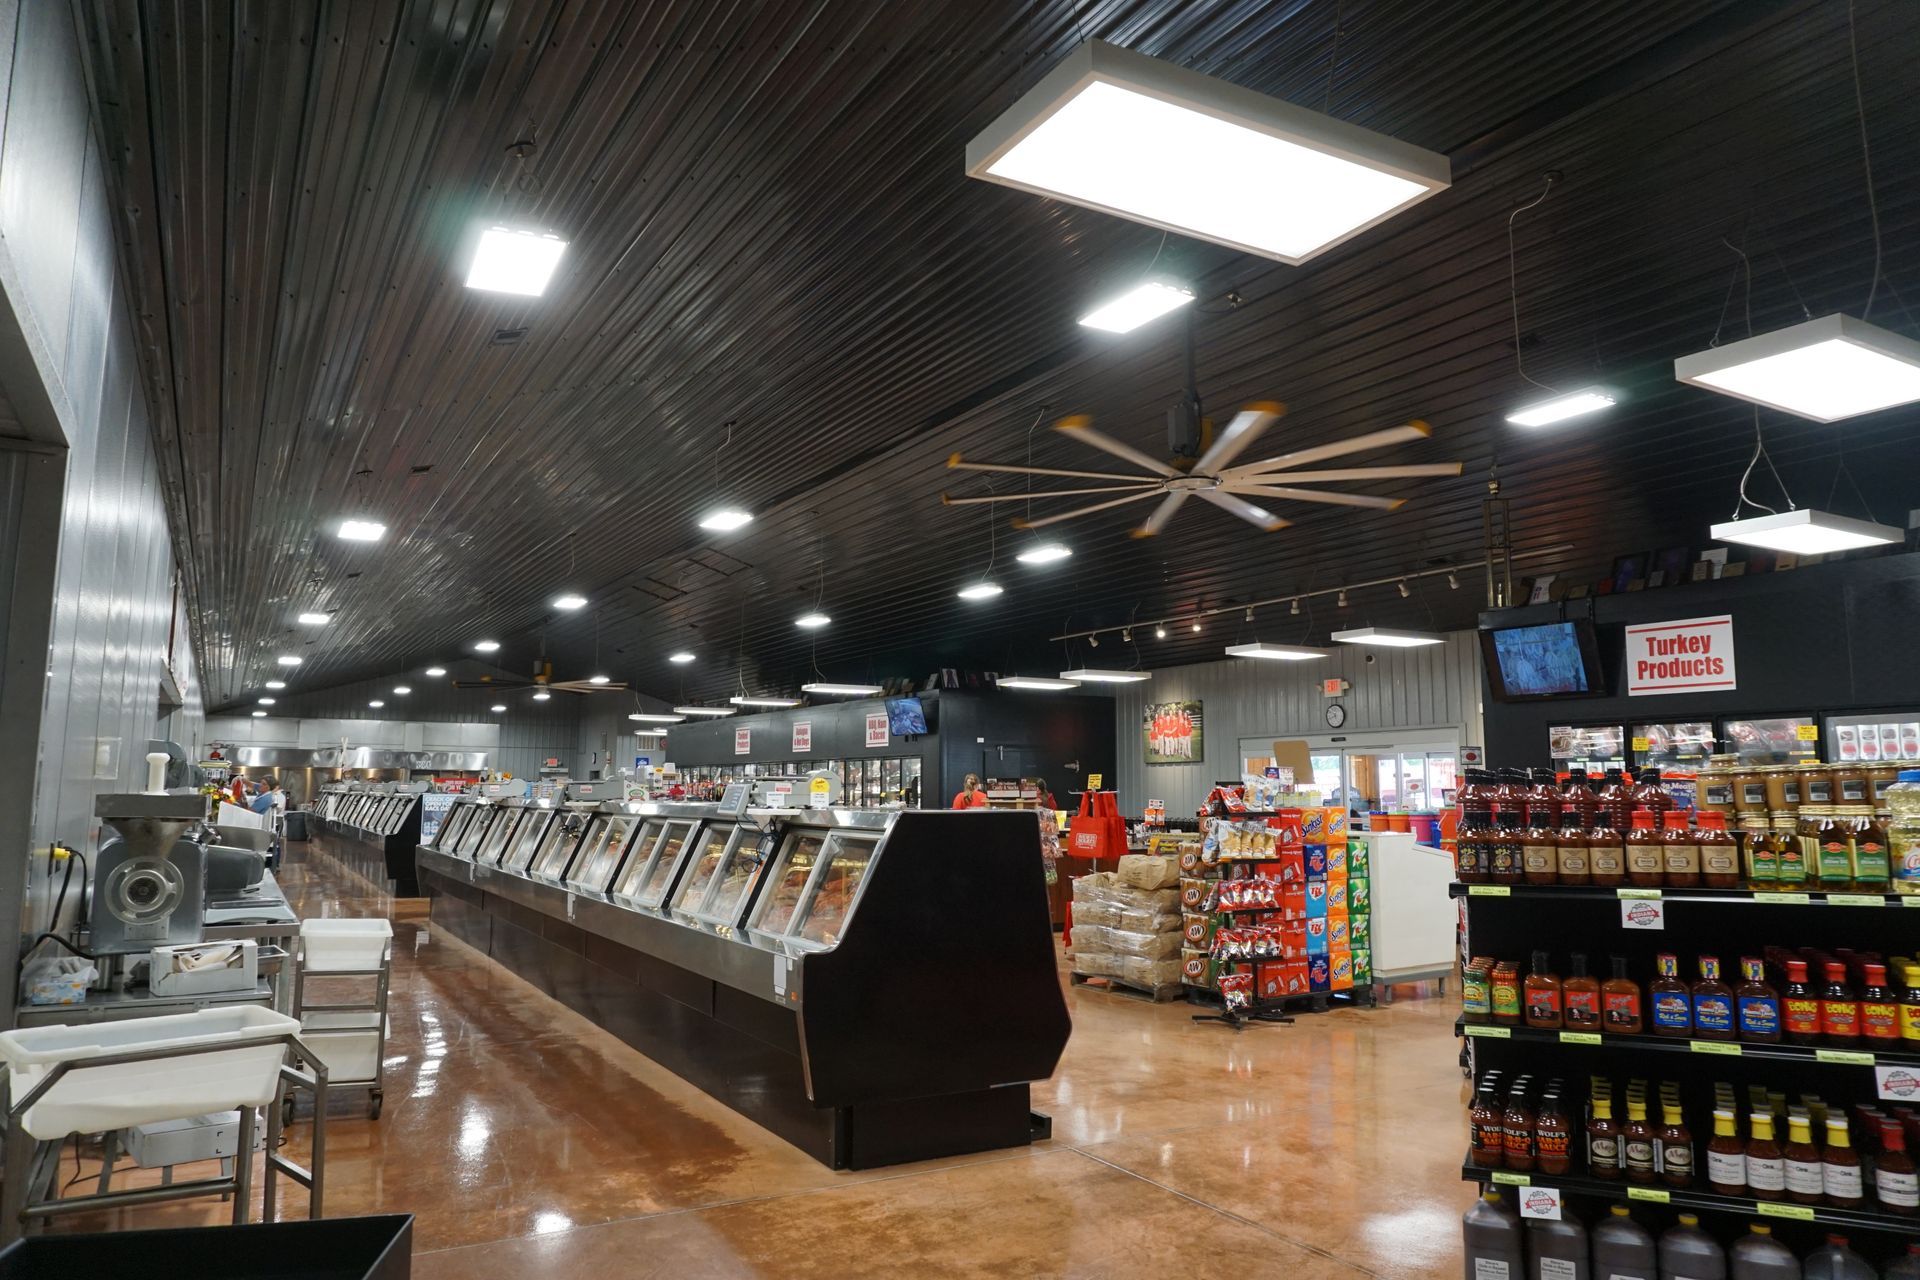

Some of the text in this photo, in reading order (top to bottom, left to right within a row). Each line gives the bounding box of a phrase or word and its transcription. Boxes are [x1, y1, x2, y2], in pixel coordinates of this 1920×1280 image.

[1646, 634, 1712, 656] Turkey
[1638, 656, 1724, 680] Products
[878, 719, 886, 728] Ham
[873, 731, 885, 740] Bacon
[1302, 814, 1322, 837] Sunkist
[1329, 815, 1344, 835] Sunkist
[1328, 851, 1344, 870] Sunkist
[1329, 888, 1344, 906] Sunkist
[1630, 910, 1655, 919] INDIANA
[1332, 923, 1346, 941] Sunkist
[1334, 959, 1351, 979] Sunkist
[1886, 1080, 1916, 1088] INDIANA
[1538, 1129, 1566, 1137] WOLF'S
